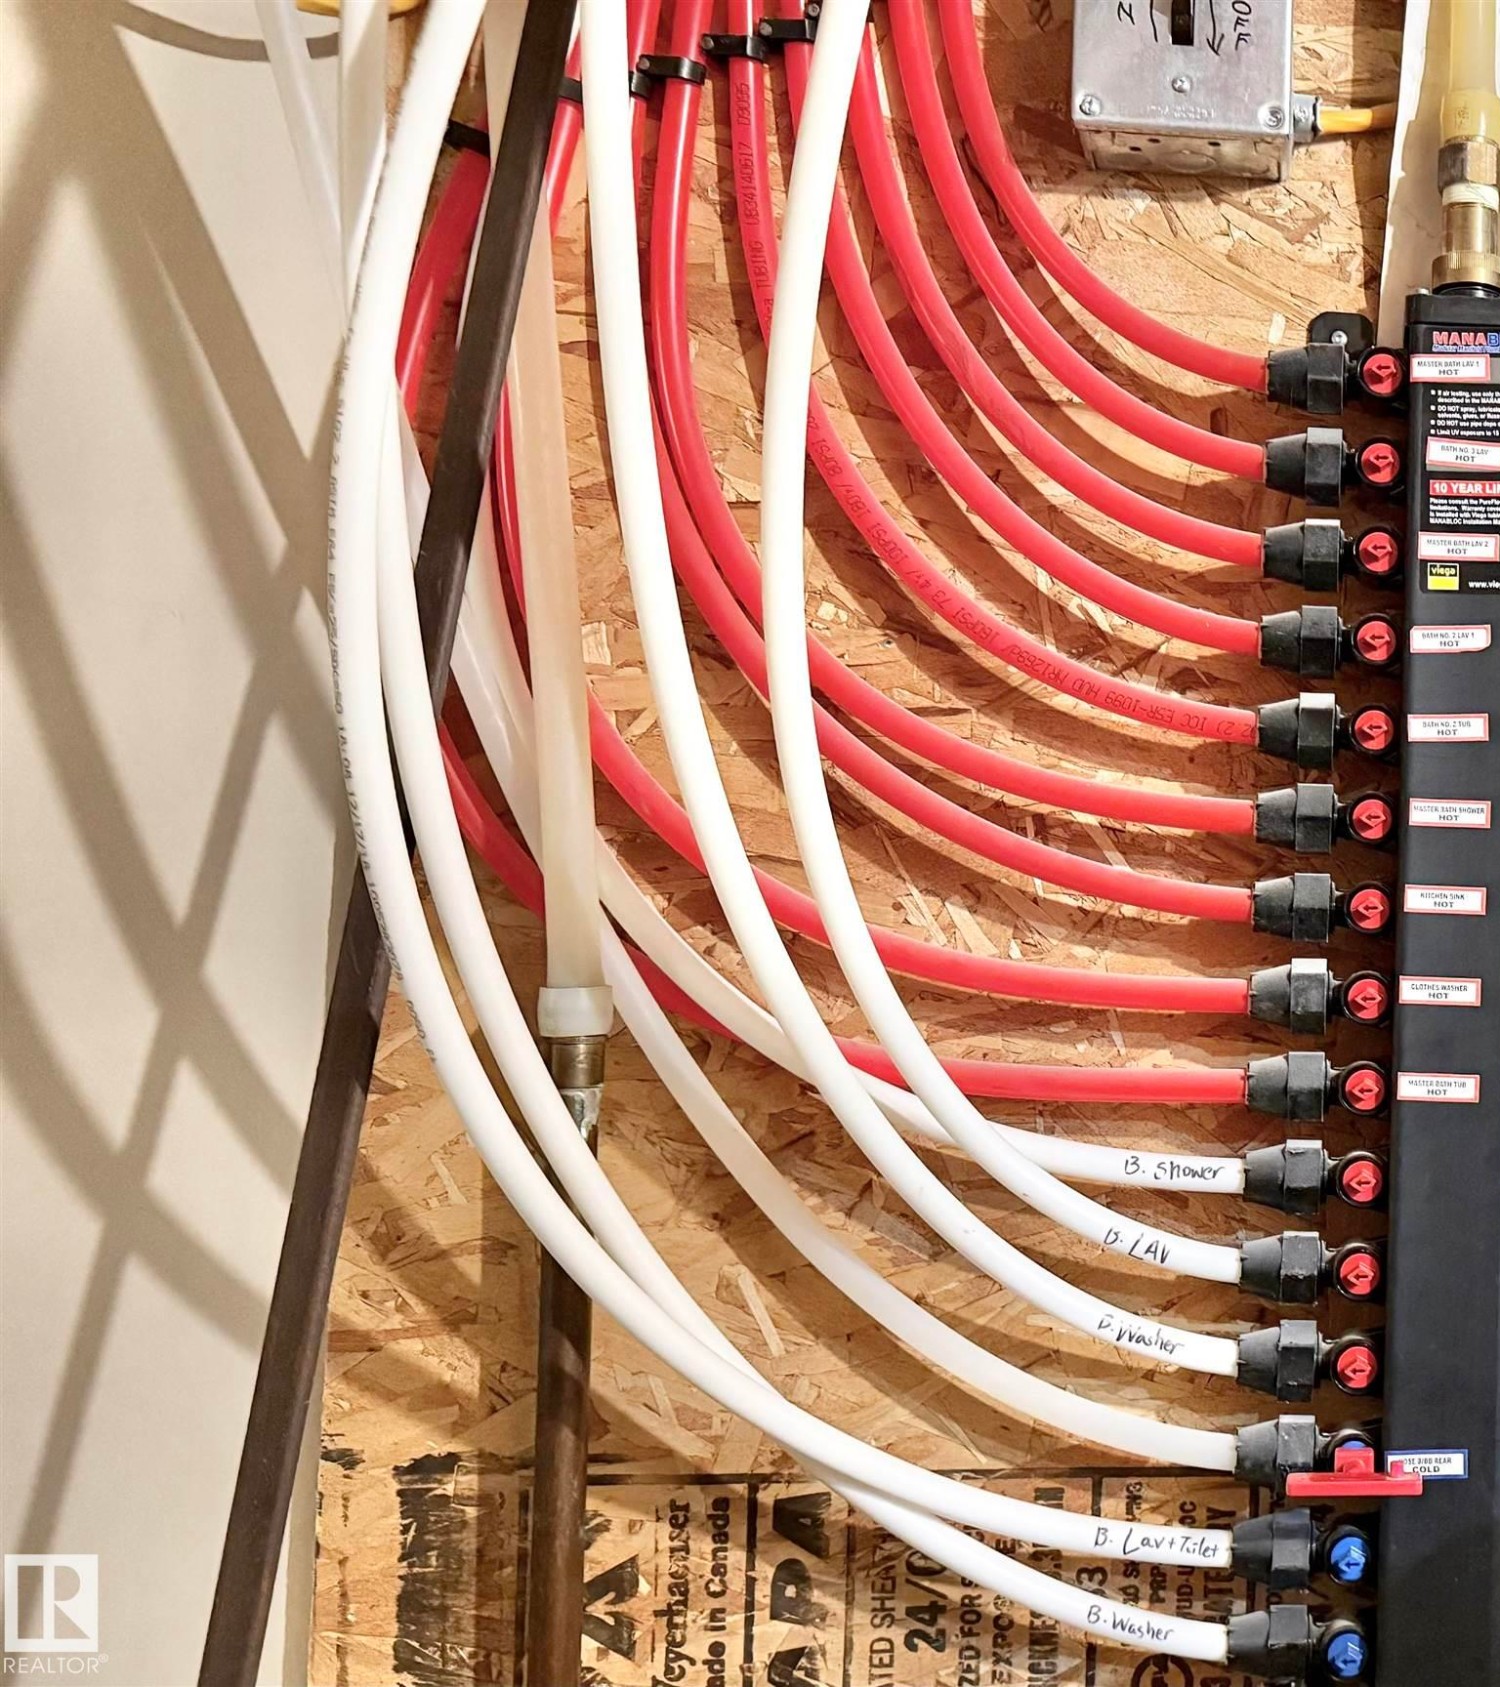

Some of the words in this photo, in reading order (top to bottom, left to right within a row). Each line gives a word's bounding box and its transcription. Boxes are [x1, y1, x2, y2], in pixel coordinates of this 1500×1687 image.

[756, 240, 771, 290] TUBING
[1455, 455, 1477, 463] HOT
[1434, 482, 1448, 494] 10
[1451, 483, 1483, 494] YEAR
[1431, 566, 1456, 576] viega
[1071, 678, 1099, 701] HUD
[1438, 814, 1460, 822] HOT
[1411, 983, 1440, 991] CLOTHES
[1441, 984, 1468, 992] WASHER
[1428, 992, 1449, 1000] HOT
[1427, 1088, 1448, 1096] HOT
[1124, 1155, 1146, 1175] B.
[1115, 1321, 1185, 1355] Washer
[1412, 1465, 1440, 1474] COLD
[1094, 1526, 1113, 1548] B.
[705, 1496, 731, 1598] Canada
[704, 1607, 727, 1632] in
[1087, 1604, 1107, 1625] B.
[1111, 1611, 1175, 1641] Washer
